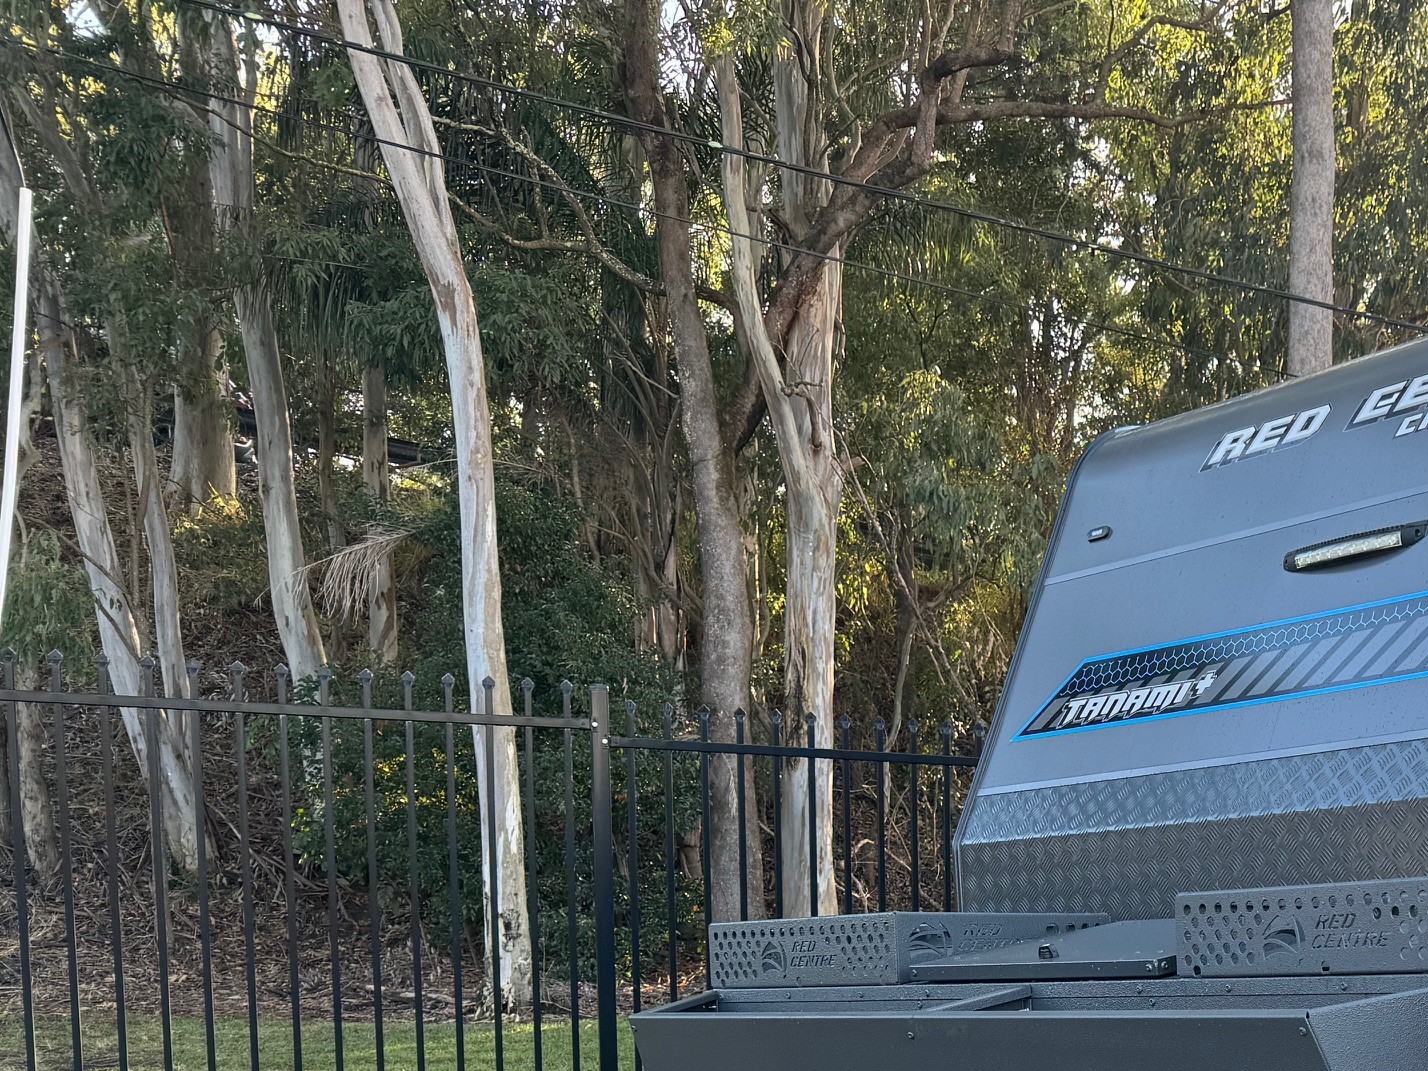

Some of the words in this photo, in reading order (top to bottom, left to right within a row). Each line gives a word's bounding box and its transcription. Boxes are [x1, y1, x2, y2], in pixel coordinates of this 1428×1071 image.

[1201, 403, 1332, 472] RED
[1315, 912, 1357, 930] RED
[791, 940, 817, 952] RED
[1311, 931, 1388, 949] CENTRE
[790, 954, 838, 967] CENTRE
